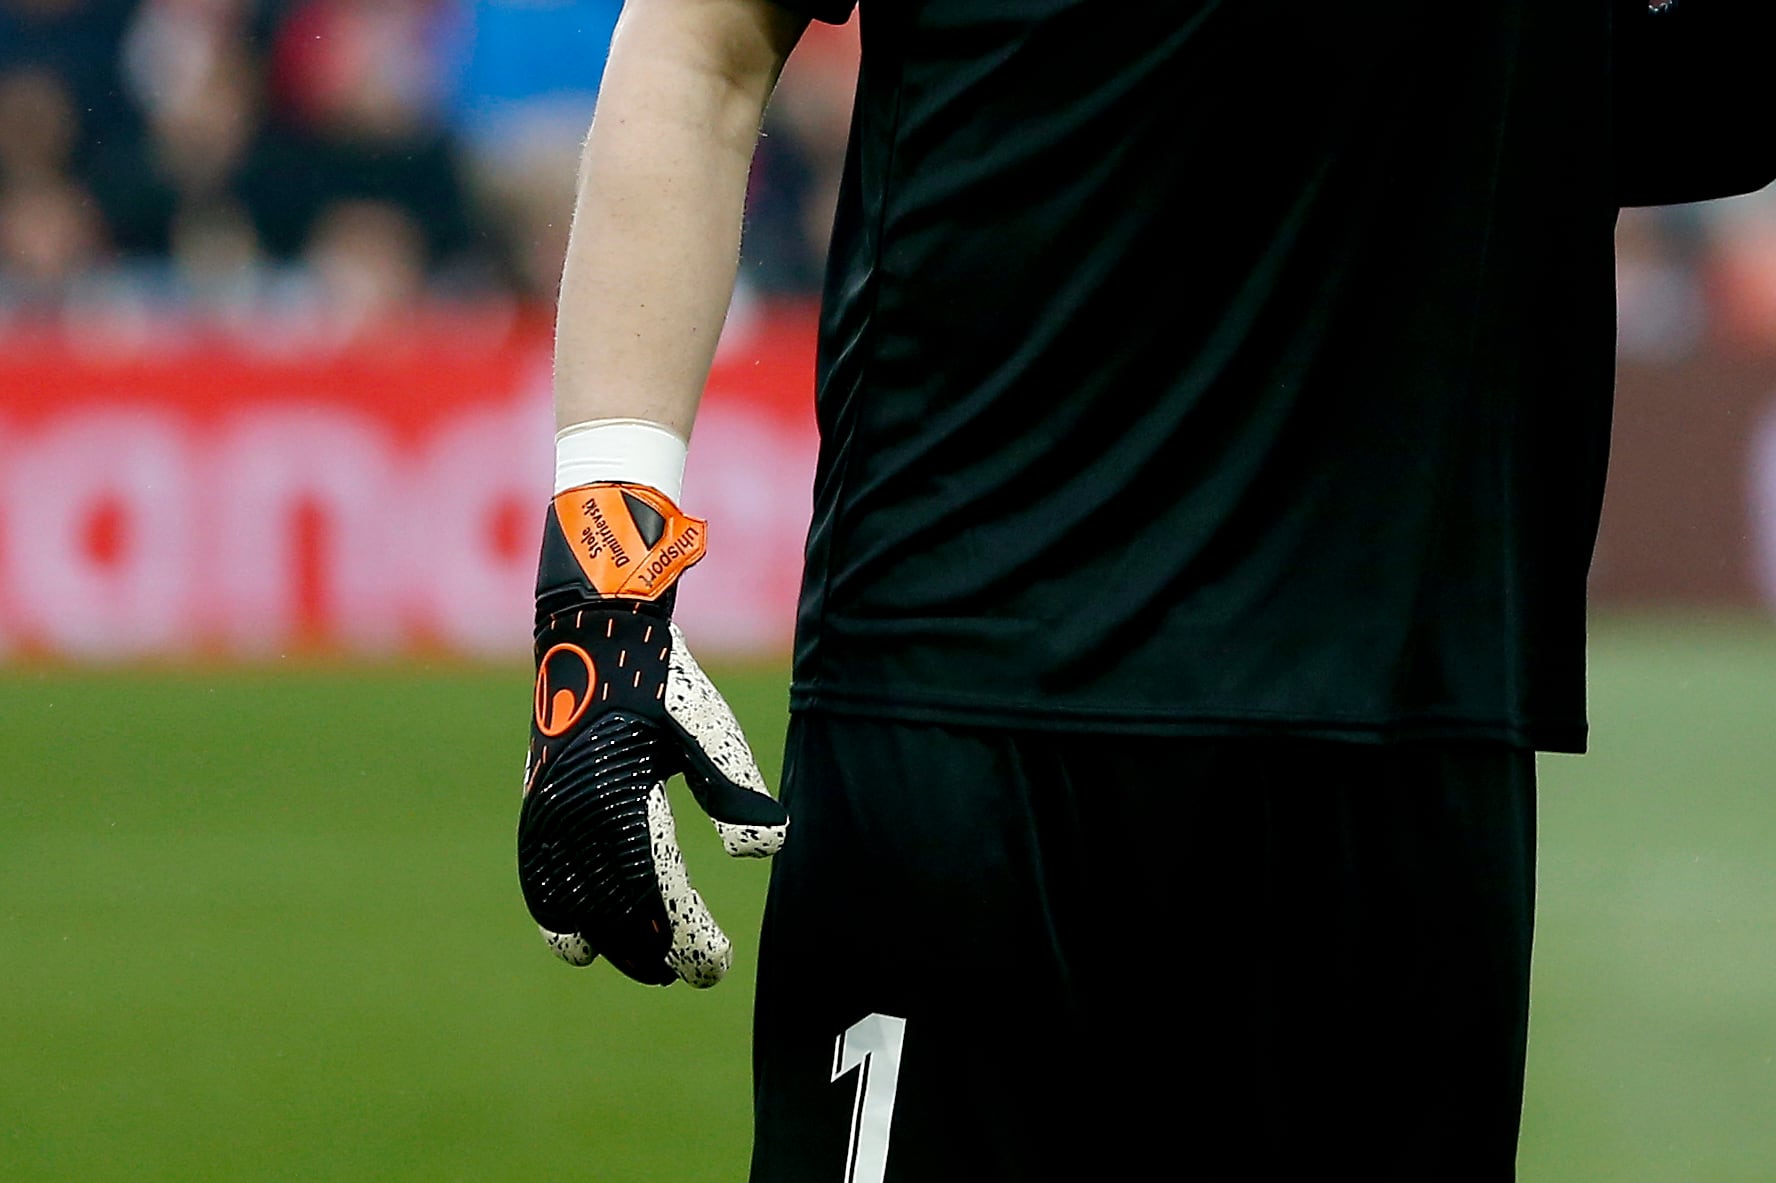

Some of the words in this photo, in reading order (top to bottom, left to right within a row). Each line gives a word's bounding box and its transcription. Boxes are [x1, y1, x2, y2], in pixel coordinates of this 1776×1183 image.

[581, 526, 603, 559] Stole
[582, 498, 631, 568] Dimitrievski
[638, 526, 699, 588] uhlsport
[831, 1013, 906, 1183] 1
